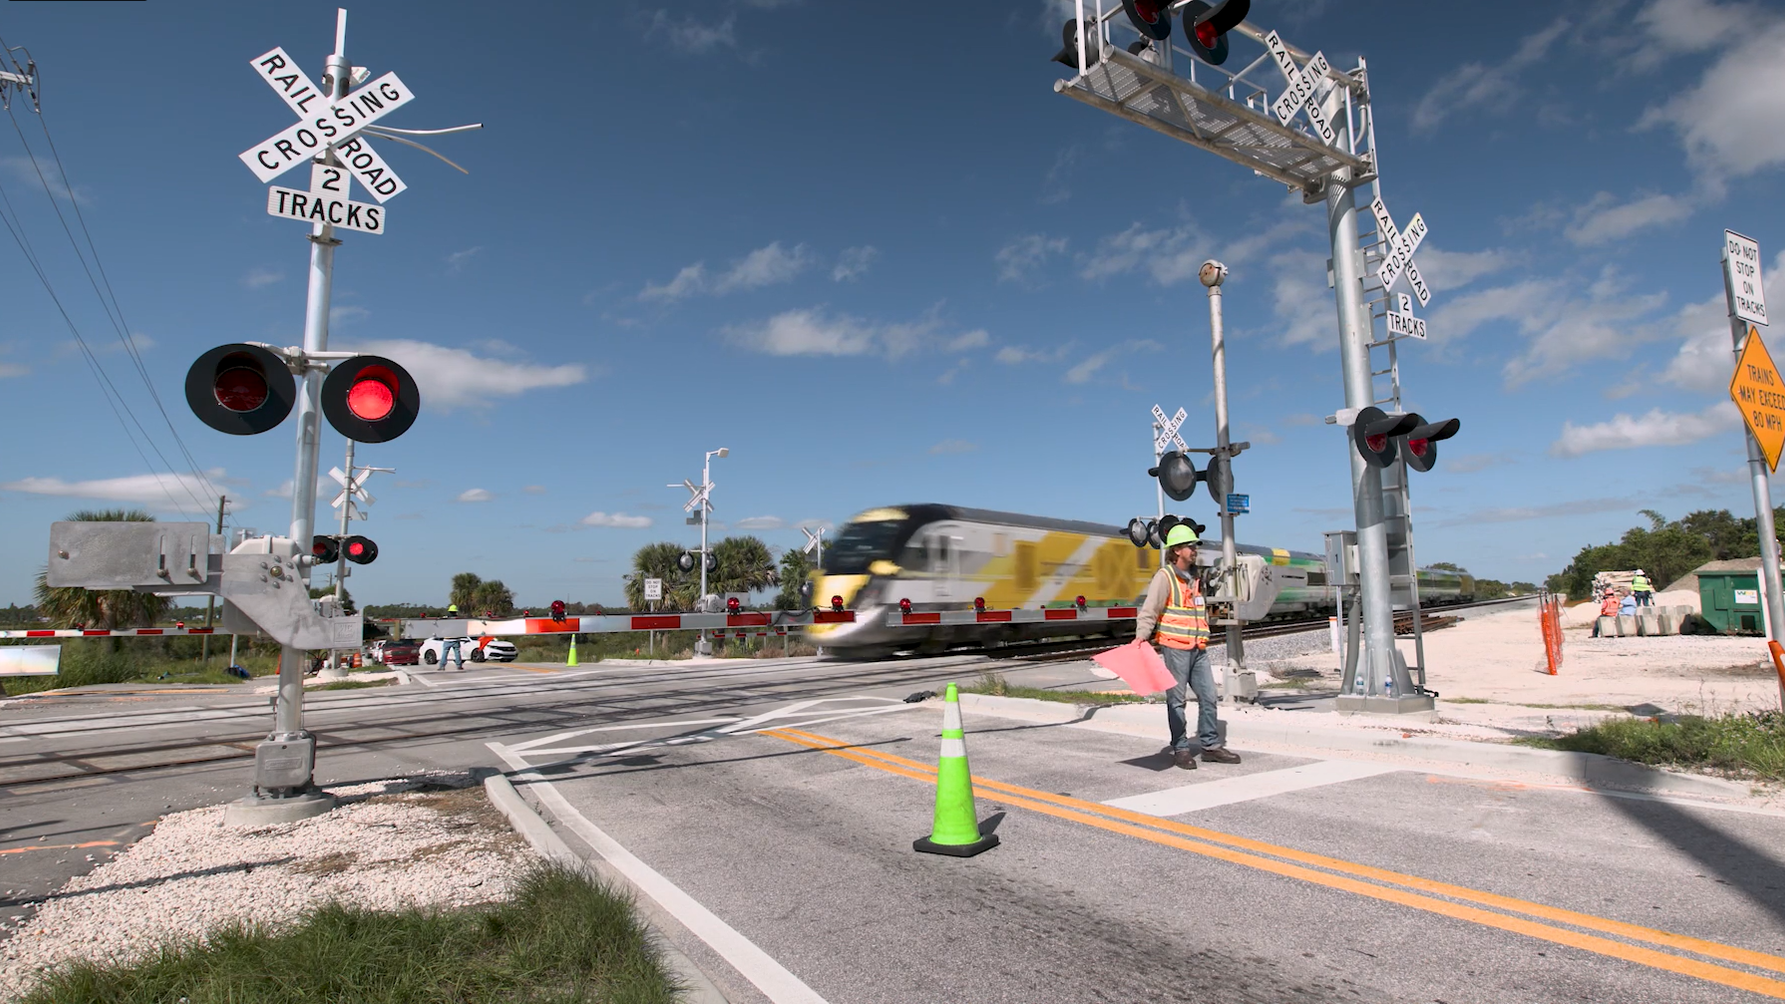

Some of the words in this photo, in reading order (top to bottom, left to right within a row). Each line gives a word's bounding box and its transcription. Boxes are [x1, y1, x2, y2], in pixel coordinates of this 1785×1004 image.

[1269, 35, 1294, 81] RAIL
[260, 54, 316, 113] RAIL
[1277, 57, 1327, 120] CROSSING
[258, 83, 399, 170] CROSSING
[1304, 97, 1331, 139] ROAD
[338, 138, 397, 196] ROAD
[322, 169, 340, 191] 2
[276, 190, 379, 230] TRACKS
[1374, 201, 1396, 244] RAIL
[1382, 219, 1424, 285] CROSSING
[1729, 241, 1740, 255] DO
[1743, 246, 1756, 262] NOT
[1404, 260, 1427, 301] ROAD
[1736, 261, 1754, 277] STOP
[1743, 281, 1754, 296] ON
[1402, 296, 1409, 311] 2
[1736, 296, 1765, 316] TRACKS
[1390, 314, 1424, 337] TRACKS
[1747, 364, 1774, 386] TRAINS
[1739, 385, 1756, 404] MAY
[1154, 407, 1167, 426] RAIL
[1753, 411, 1764, 428] 80
[1765, 413, 1782, 432] MPH
[1158, 411, 1185, 448] CROSSING
[1172, 433, 1184, 448] ROA
